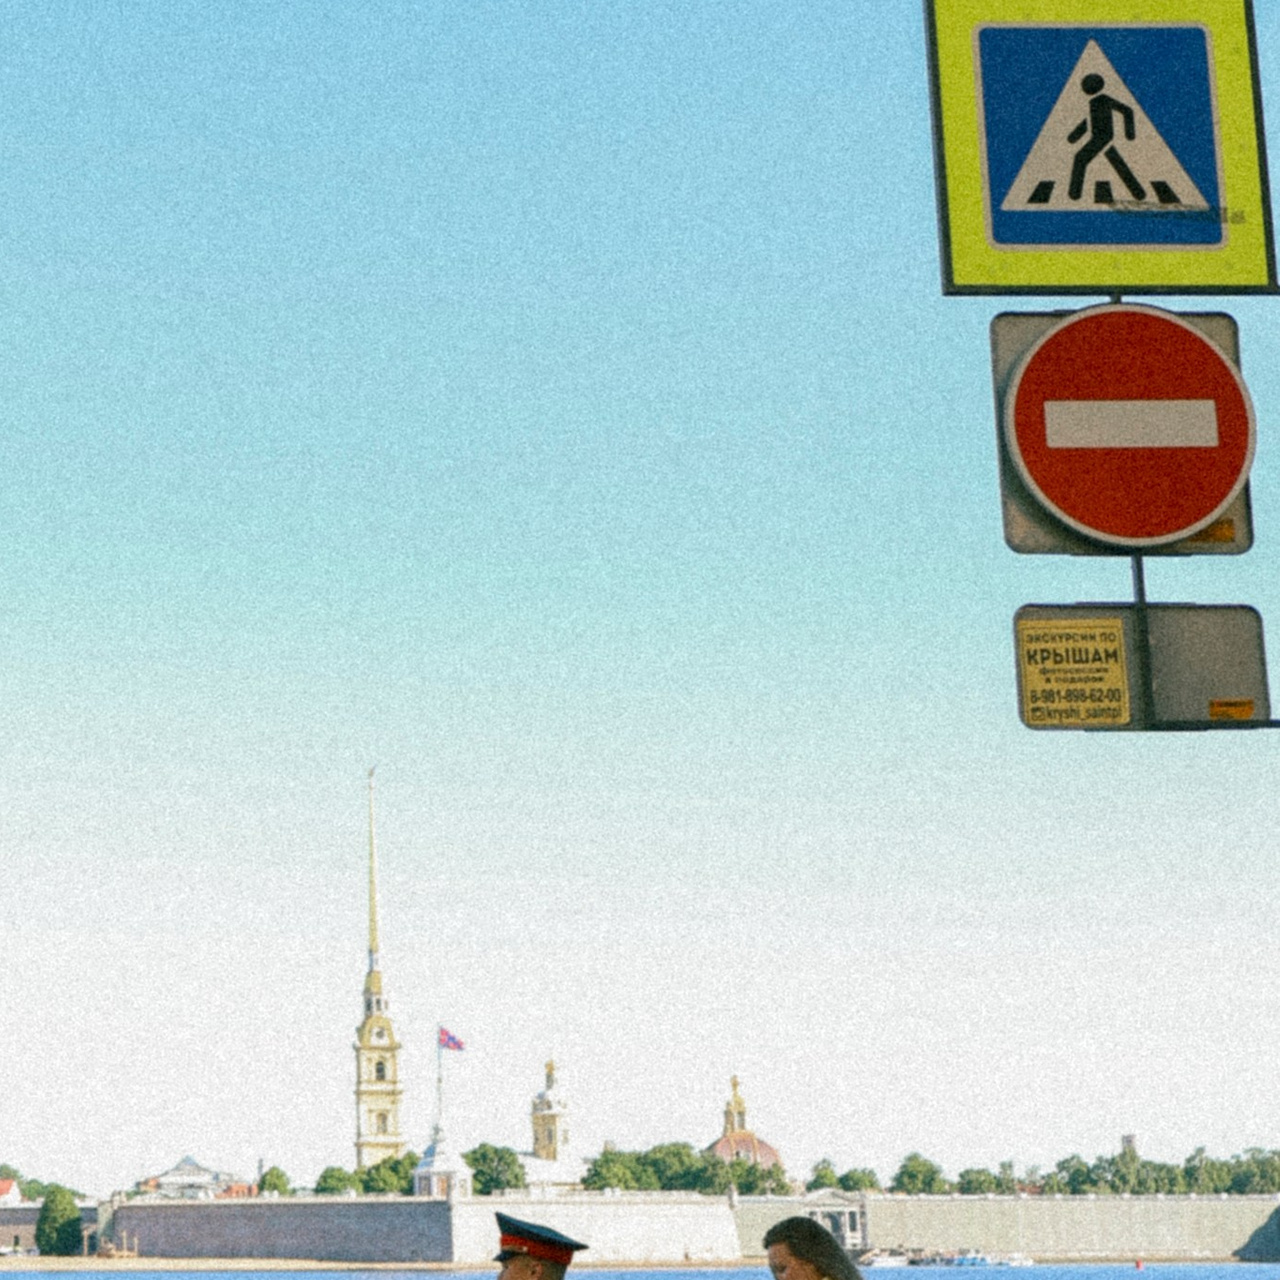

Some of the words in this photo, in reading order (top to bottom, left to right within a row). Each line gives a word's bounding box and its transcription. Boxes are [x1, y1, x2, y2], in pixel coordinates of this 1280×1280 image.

[1026, 632, 1096, 643] ЭКСКУРСИИ
[1100, 631, 1116, 642] ПО
[1026, 647, 1119, 665] КРЫШАМ
